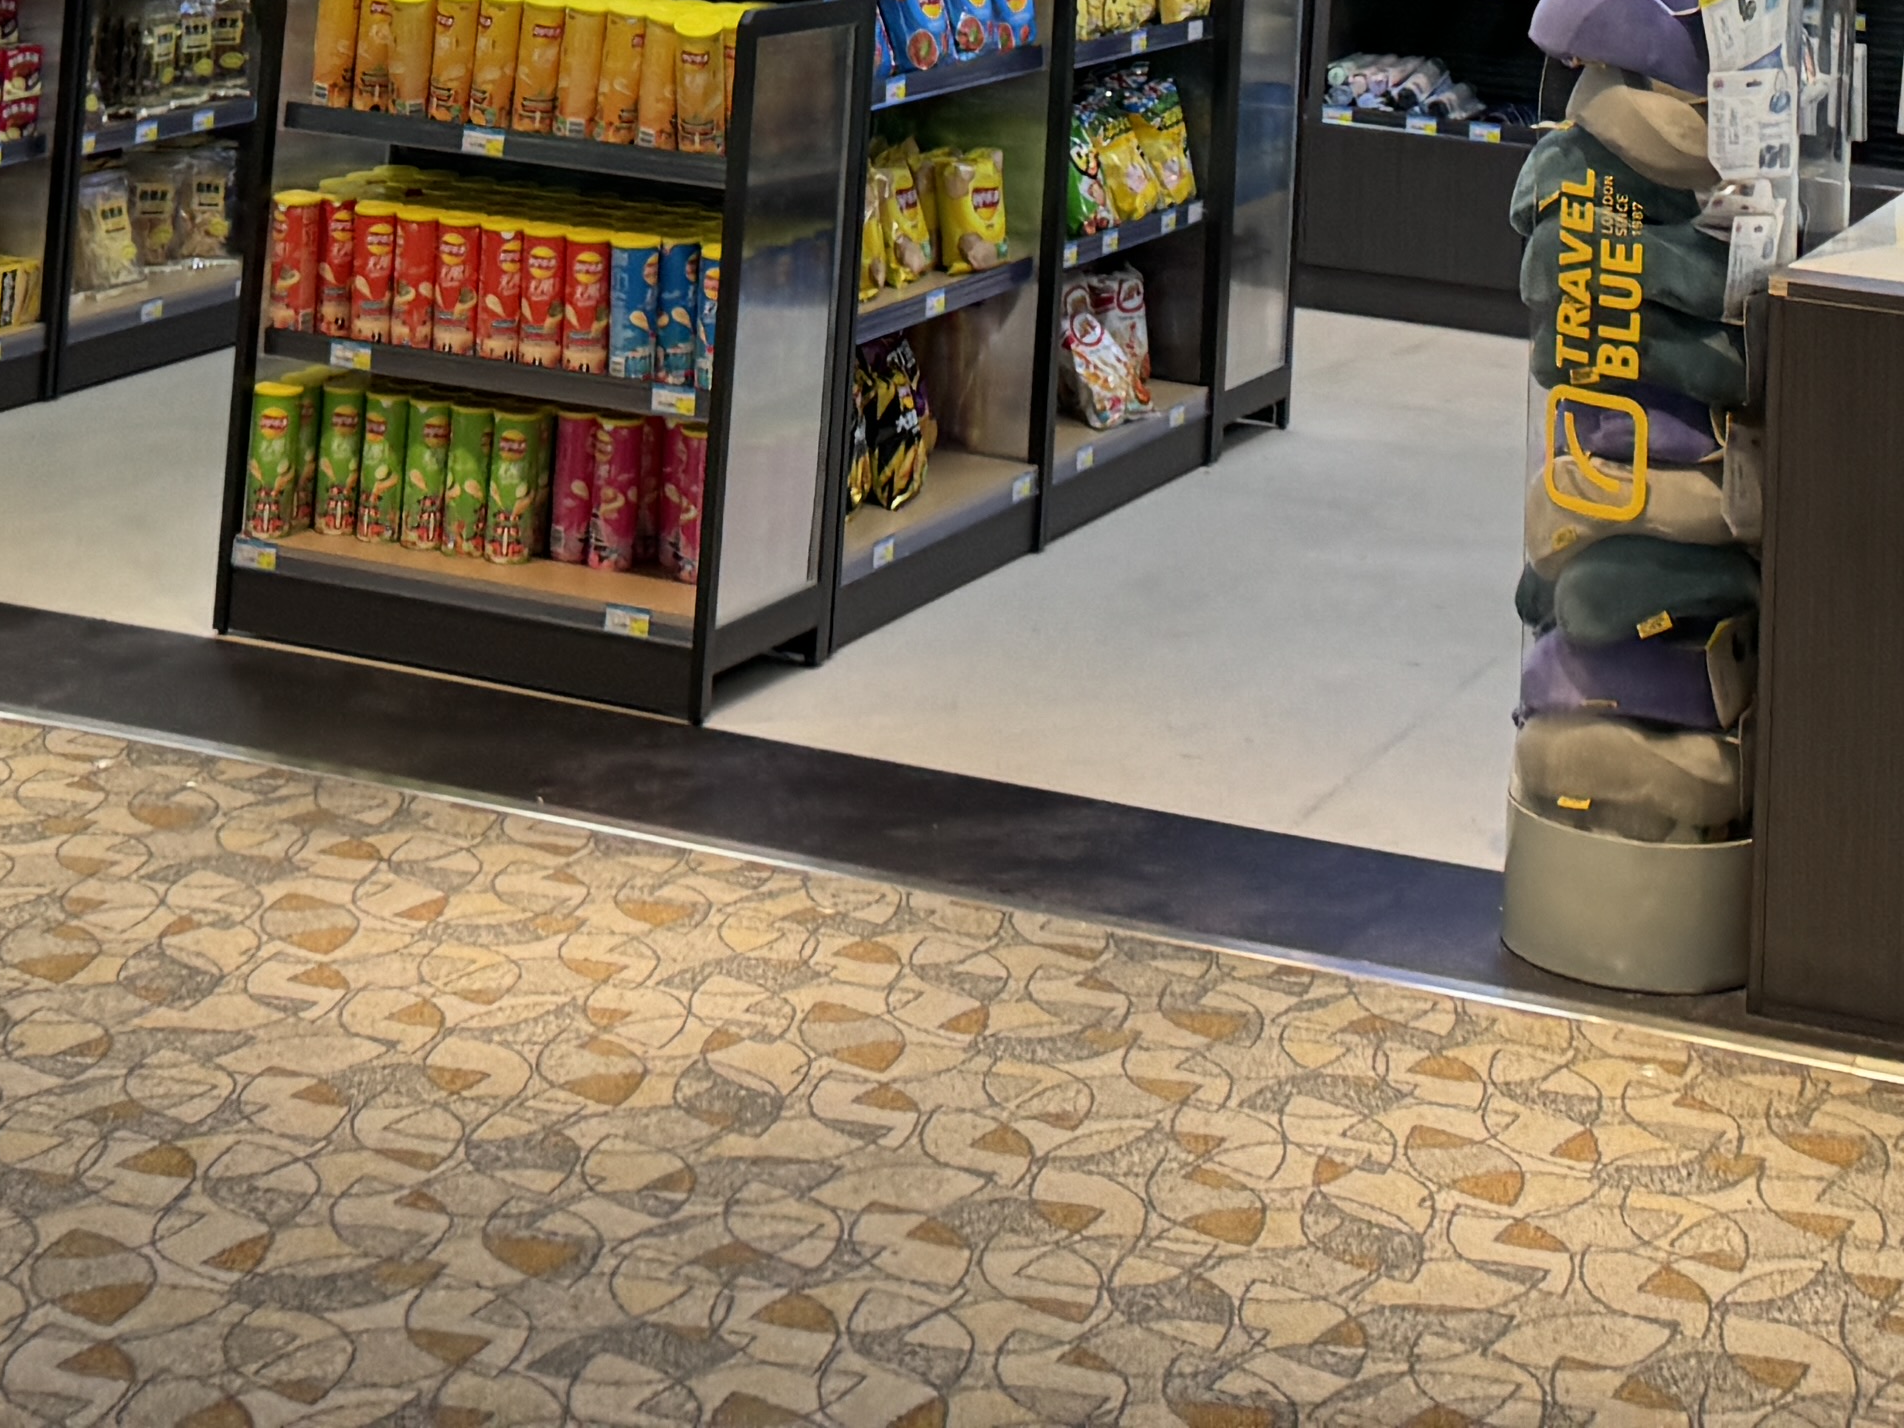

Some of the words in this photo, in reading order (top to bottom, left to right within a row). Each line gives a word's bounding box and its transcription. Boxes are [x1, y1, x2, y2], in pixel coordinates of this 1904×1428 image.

[1601, 174, 1614, 235] LONDON
[1615, 194, 1629, 238] SINCE
[1555, 167, 1596, 369] TRAVEL
[1597, 238, 1643, 381] BLUE
